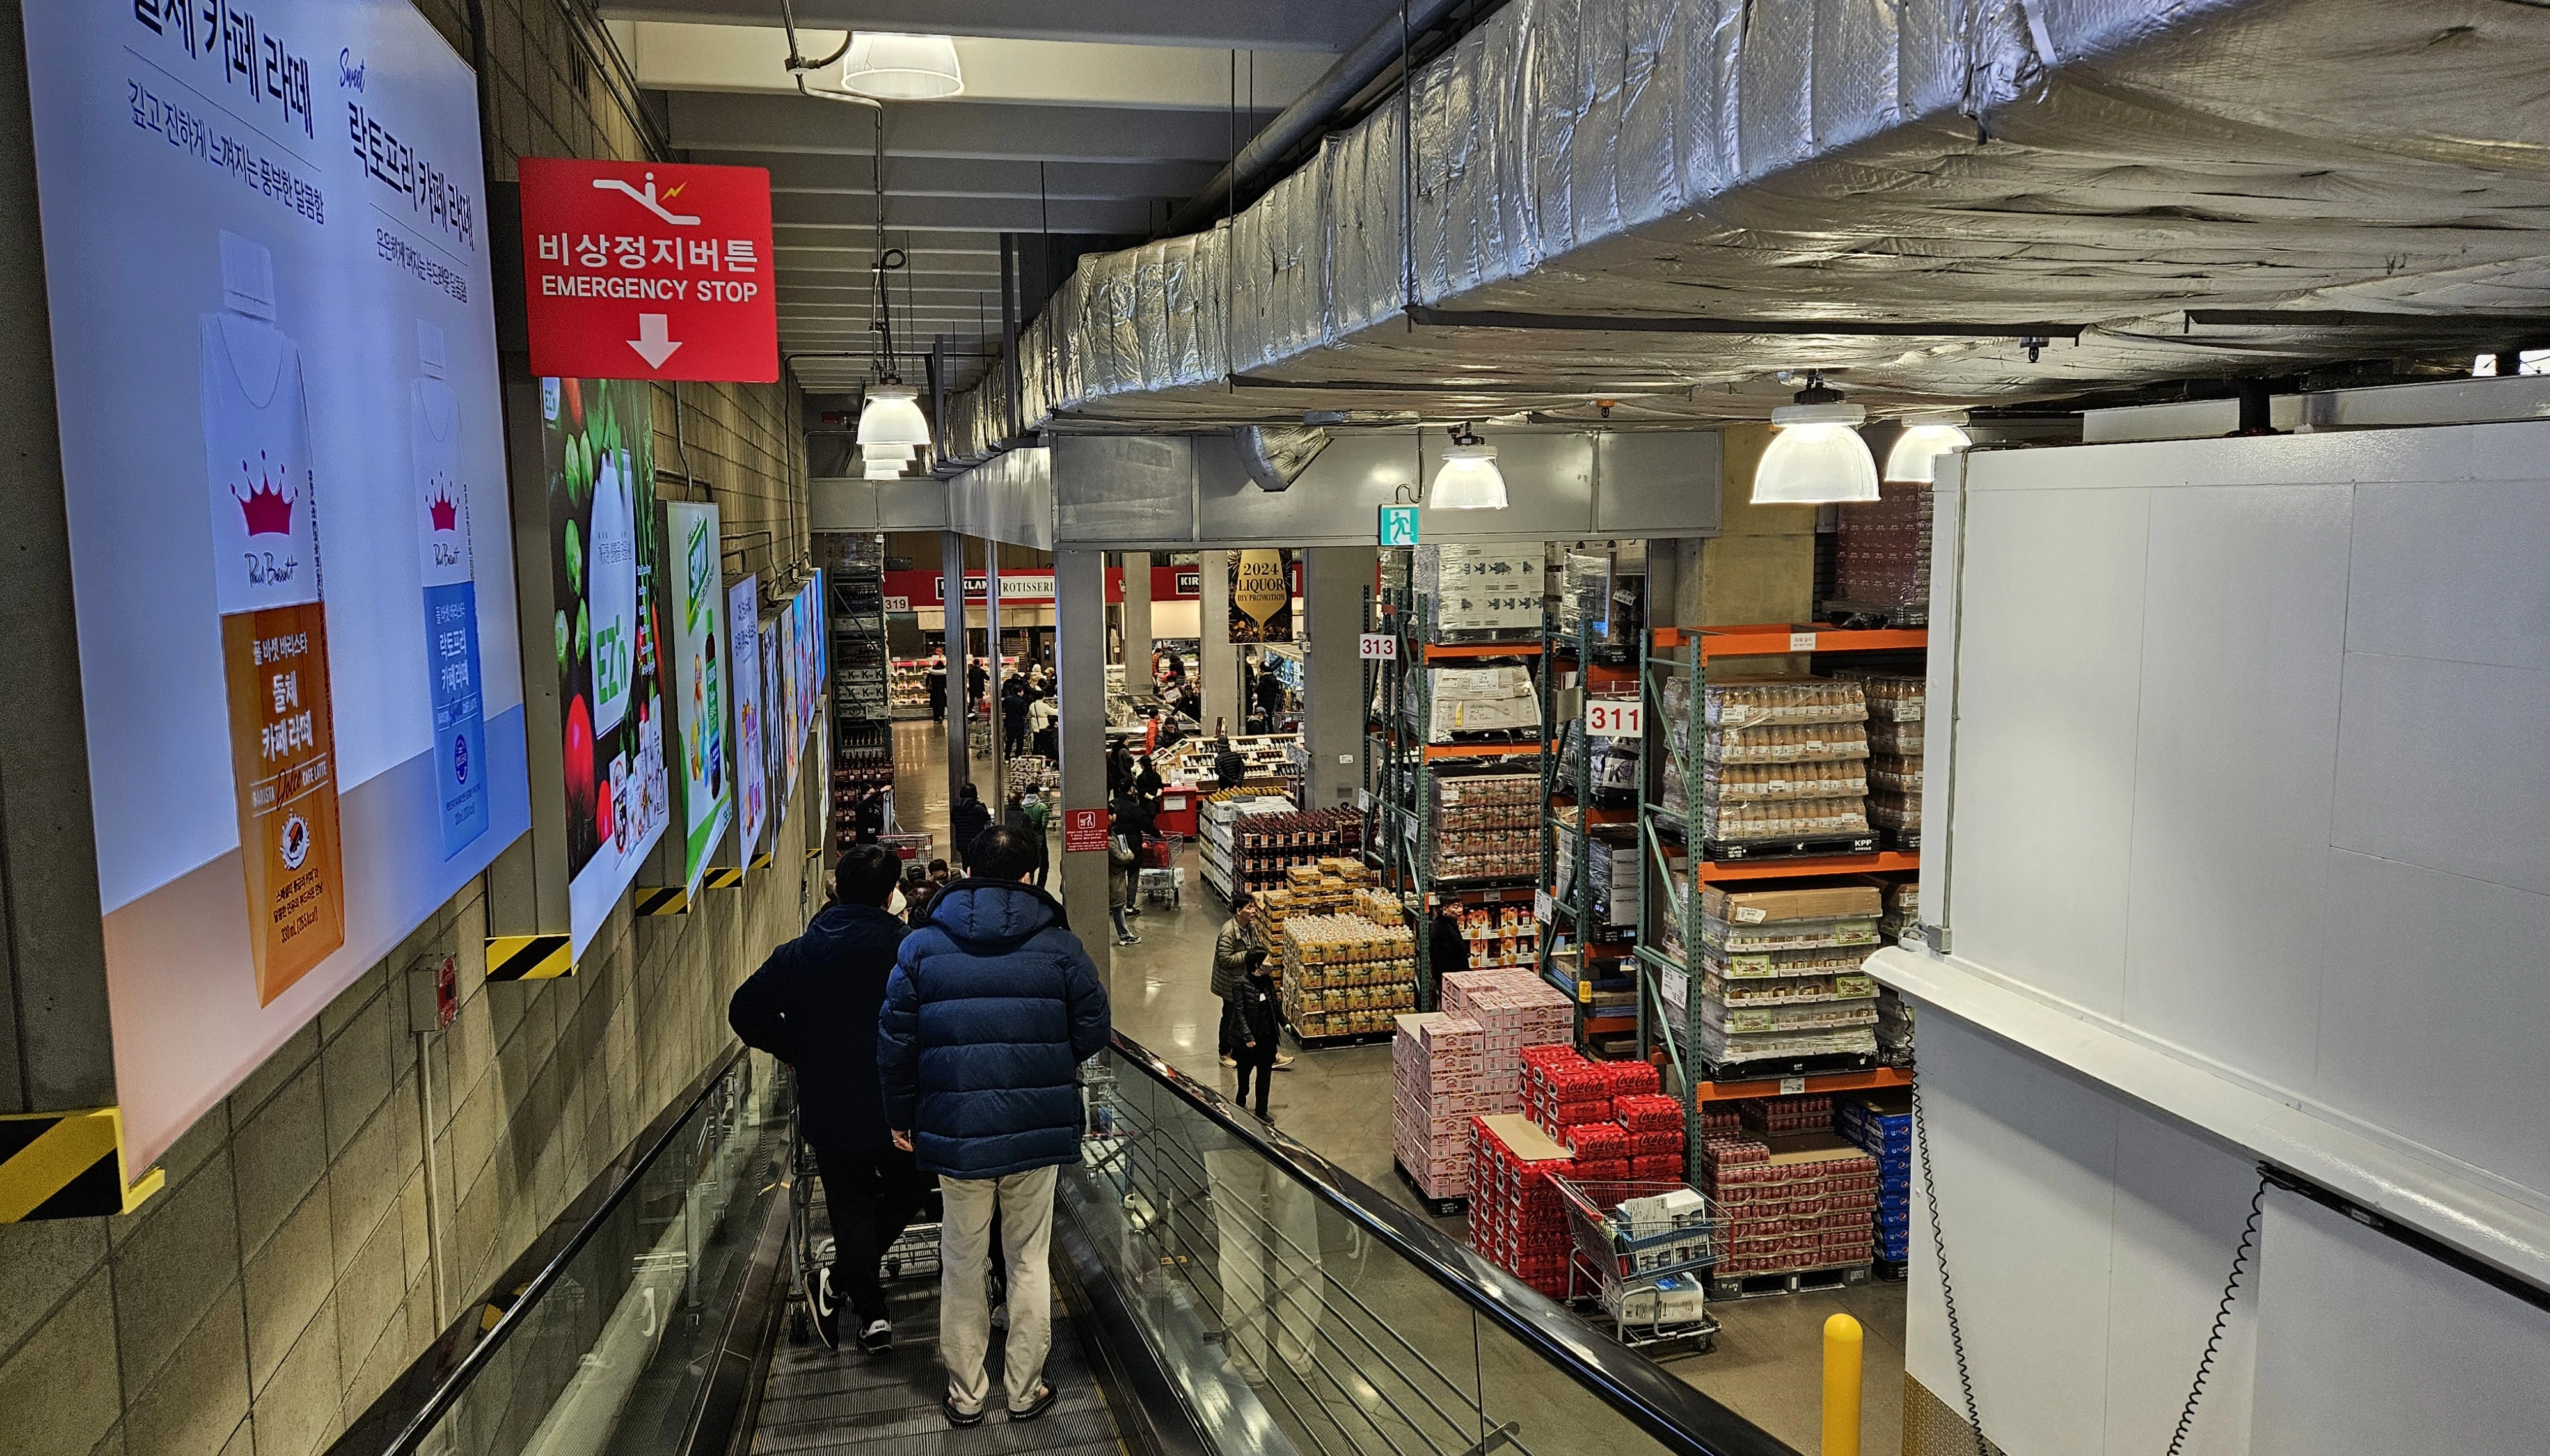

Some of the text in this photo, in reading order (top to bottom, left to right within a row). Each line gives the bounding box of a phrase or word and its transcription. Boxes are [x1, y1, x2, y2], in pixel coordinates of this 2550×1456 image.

[202, 0, 260, 104] 카페
[263, 32, 314, 140] 라떼
[340, 47, 366, 94] Sweet
[128, 77, 324, 225] 깊고 진하게 느껴지는 풍부한 달콤함
[348, 100, 475, 252] 락토프리 카페 라떼
[539, 232, 758, 273] 비상정지버튼
[542, 275, 758, 303] EMERGENCY STOP
[1243, 562, 1279, 576] 2024
[1002, 582, 1054, 592] ROTISSERI
[1239, 578, 1285, 594] LIQUOR
[885, 599, 907, 610] 319
[279, 631, 308, 660] 바리스타
[439, 627, 468, 663] 락토프리
[1362, 638, 1394, 655] 313
[273, 670, 299, 715] 돌체
[1590, 706, 1639, 731] 311
[262, 709, 313, 763] 카페 라떼
[253, 785, 276, 809] BARISTA
[313, 760, 328, 780] LATTE
[1855, 839, 1873, 847] KPP
[1616, 1072, 1656, 1088] Coca-Cola
[1638, 1107, 1680, 1125] Coca-Cola
[1585, 1136, 1627, 1151] Coca-Cola
[1638, 1130, 1679, 1147] Coca-Cola
